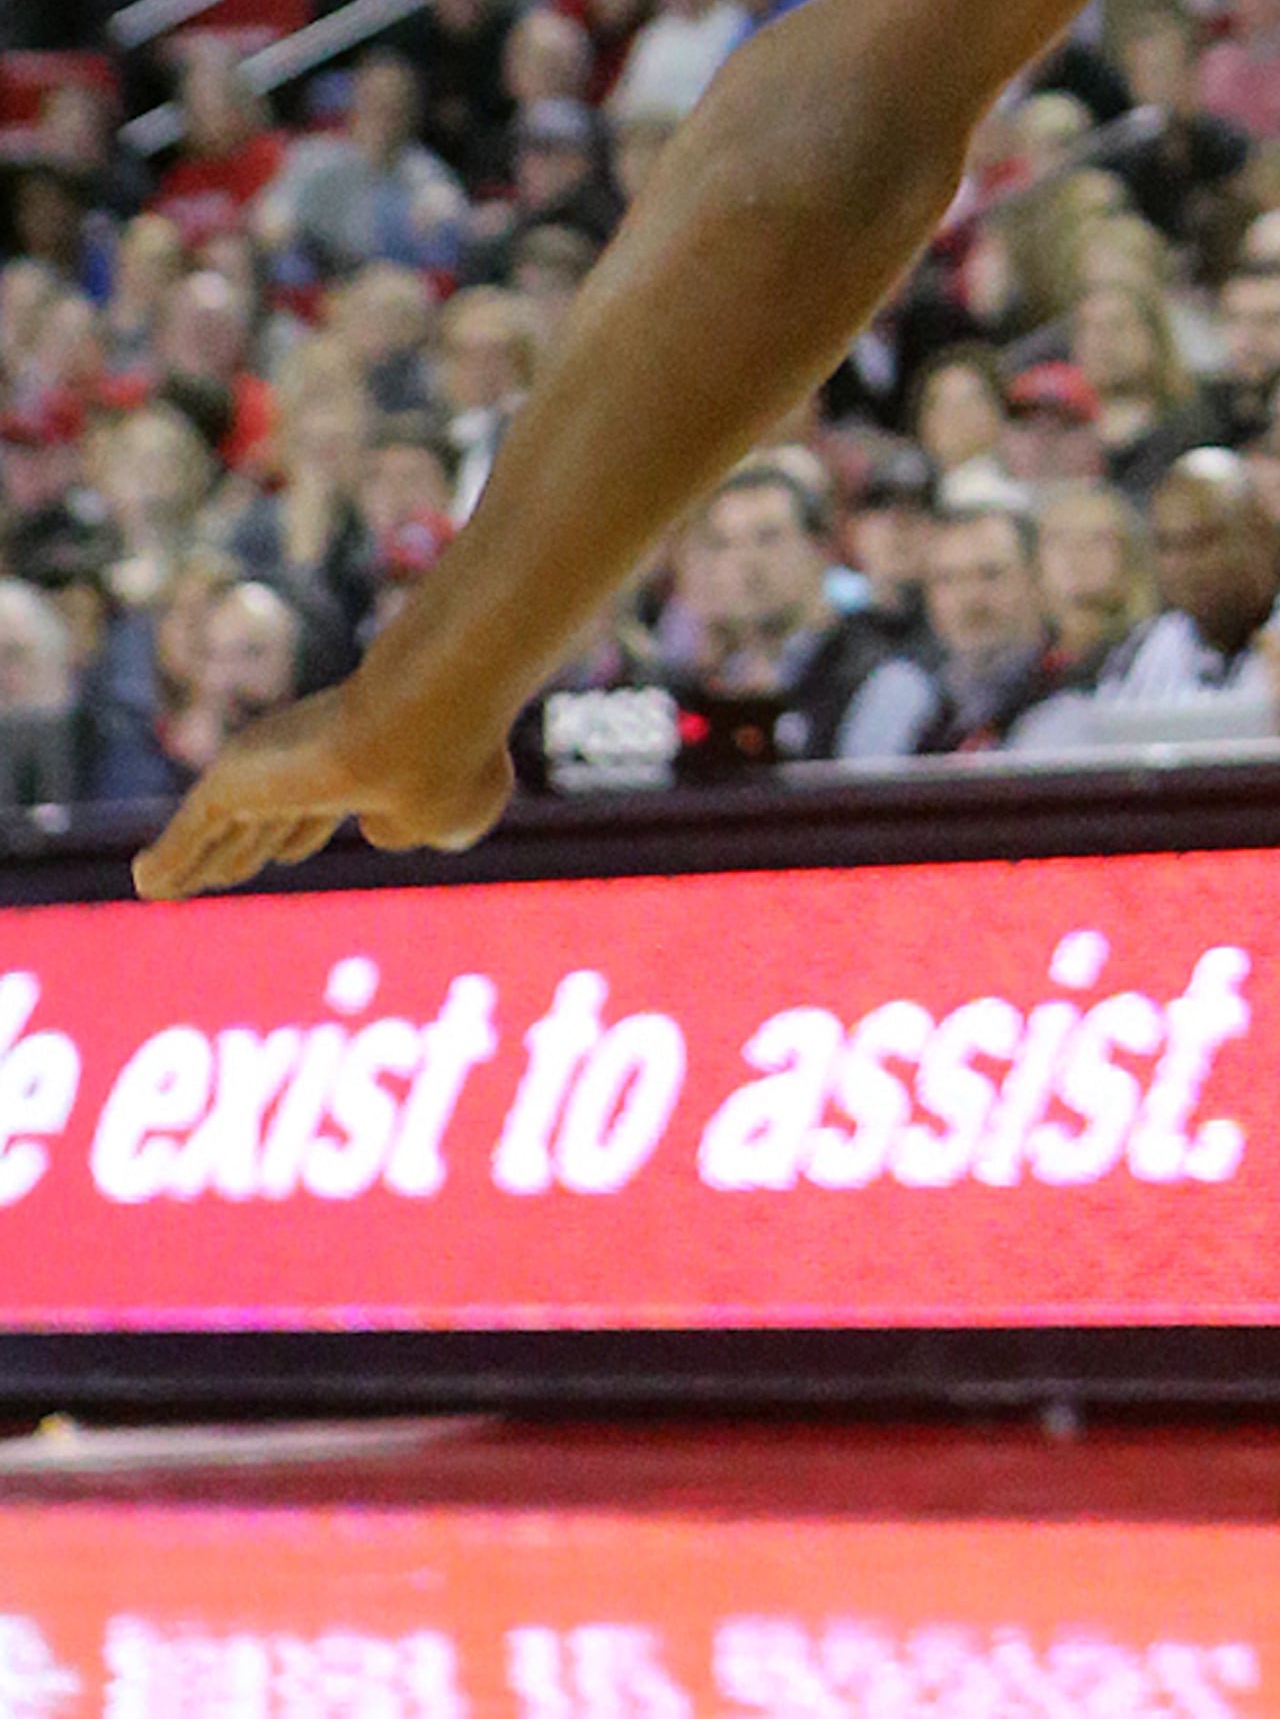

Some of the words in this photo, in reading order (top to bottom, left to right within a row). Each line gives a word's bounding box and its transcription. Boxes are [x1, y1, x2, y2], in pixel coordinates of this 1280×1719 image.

[89, 956, 498, 1203] exist
[491, 969, 687, 1195] to
[697, 929, 1251, 1191] assist.
